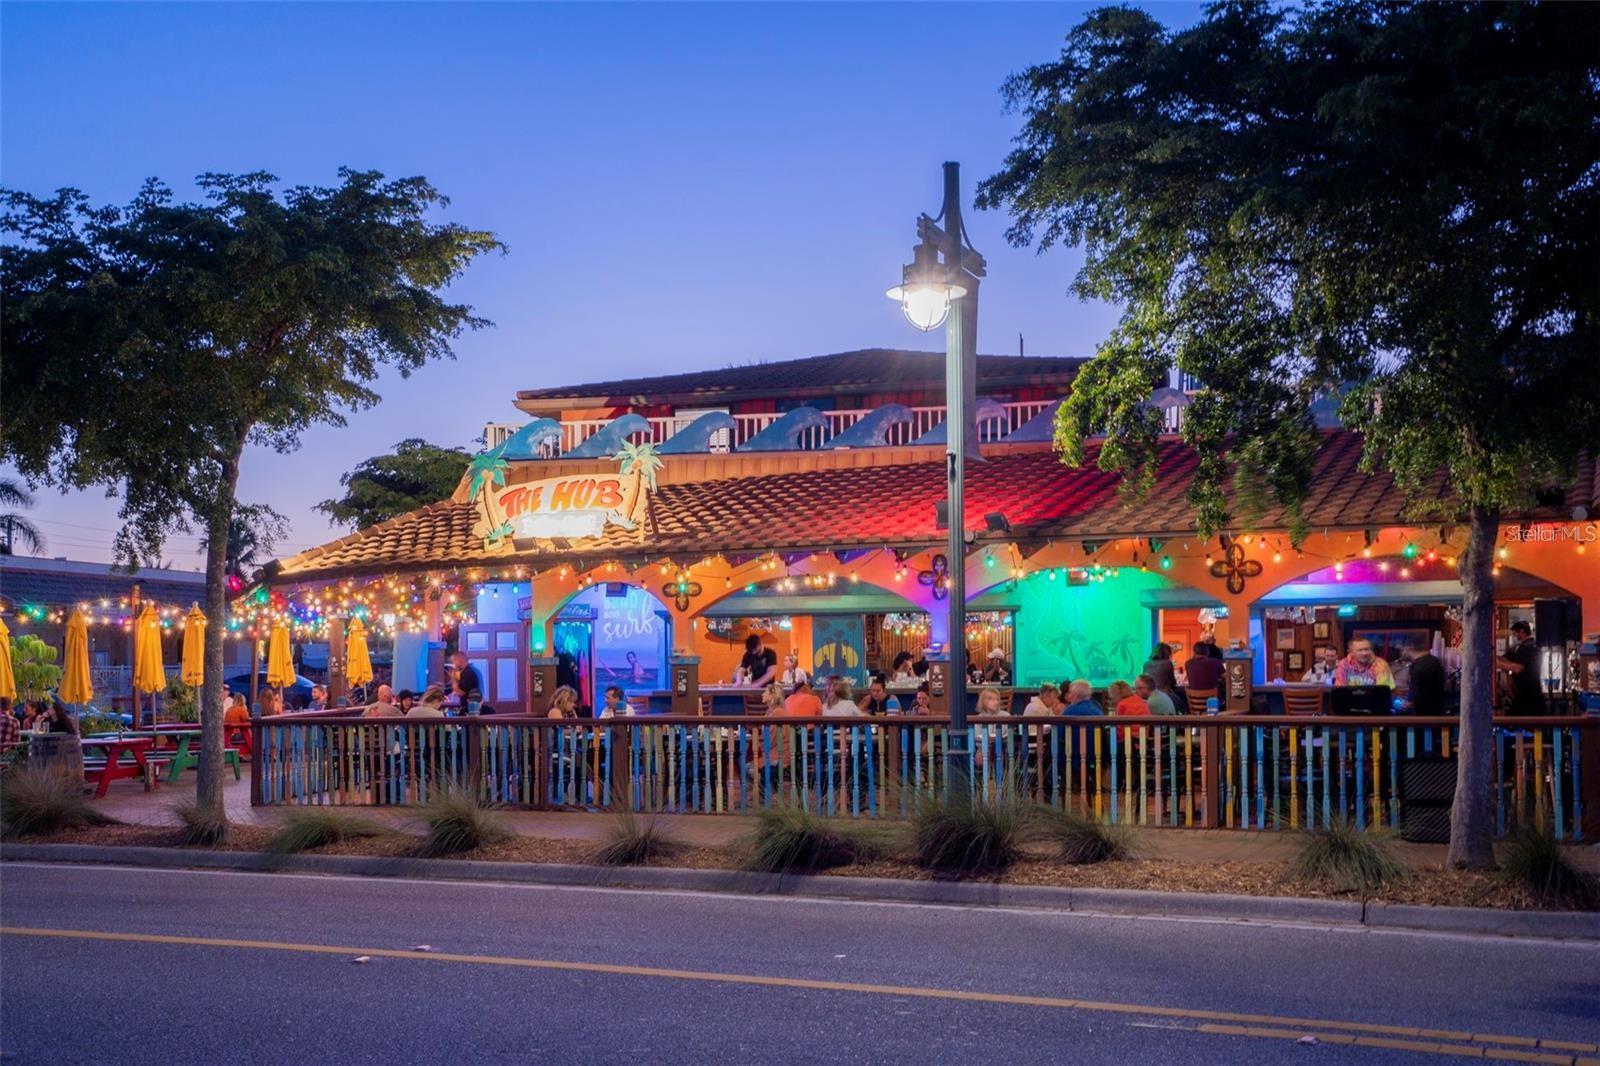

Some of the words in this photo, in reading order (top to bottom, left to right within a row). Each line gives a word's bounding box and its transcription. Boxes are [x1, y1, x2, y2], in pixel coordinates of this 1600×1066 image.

[499, 486, 543, 518] THE
[551, 478, 624, 512] HUB
[603, 592, 656, 644] surf
